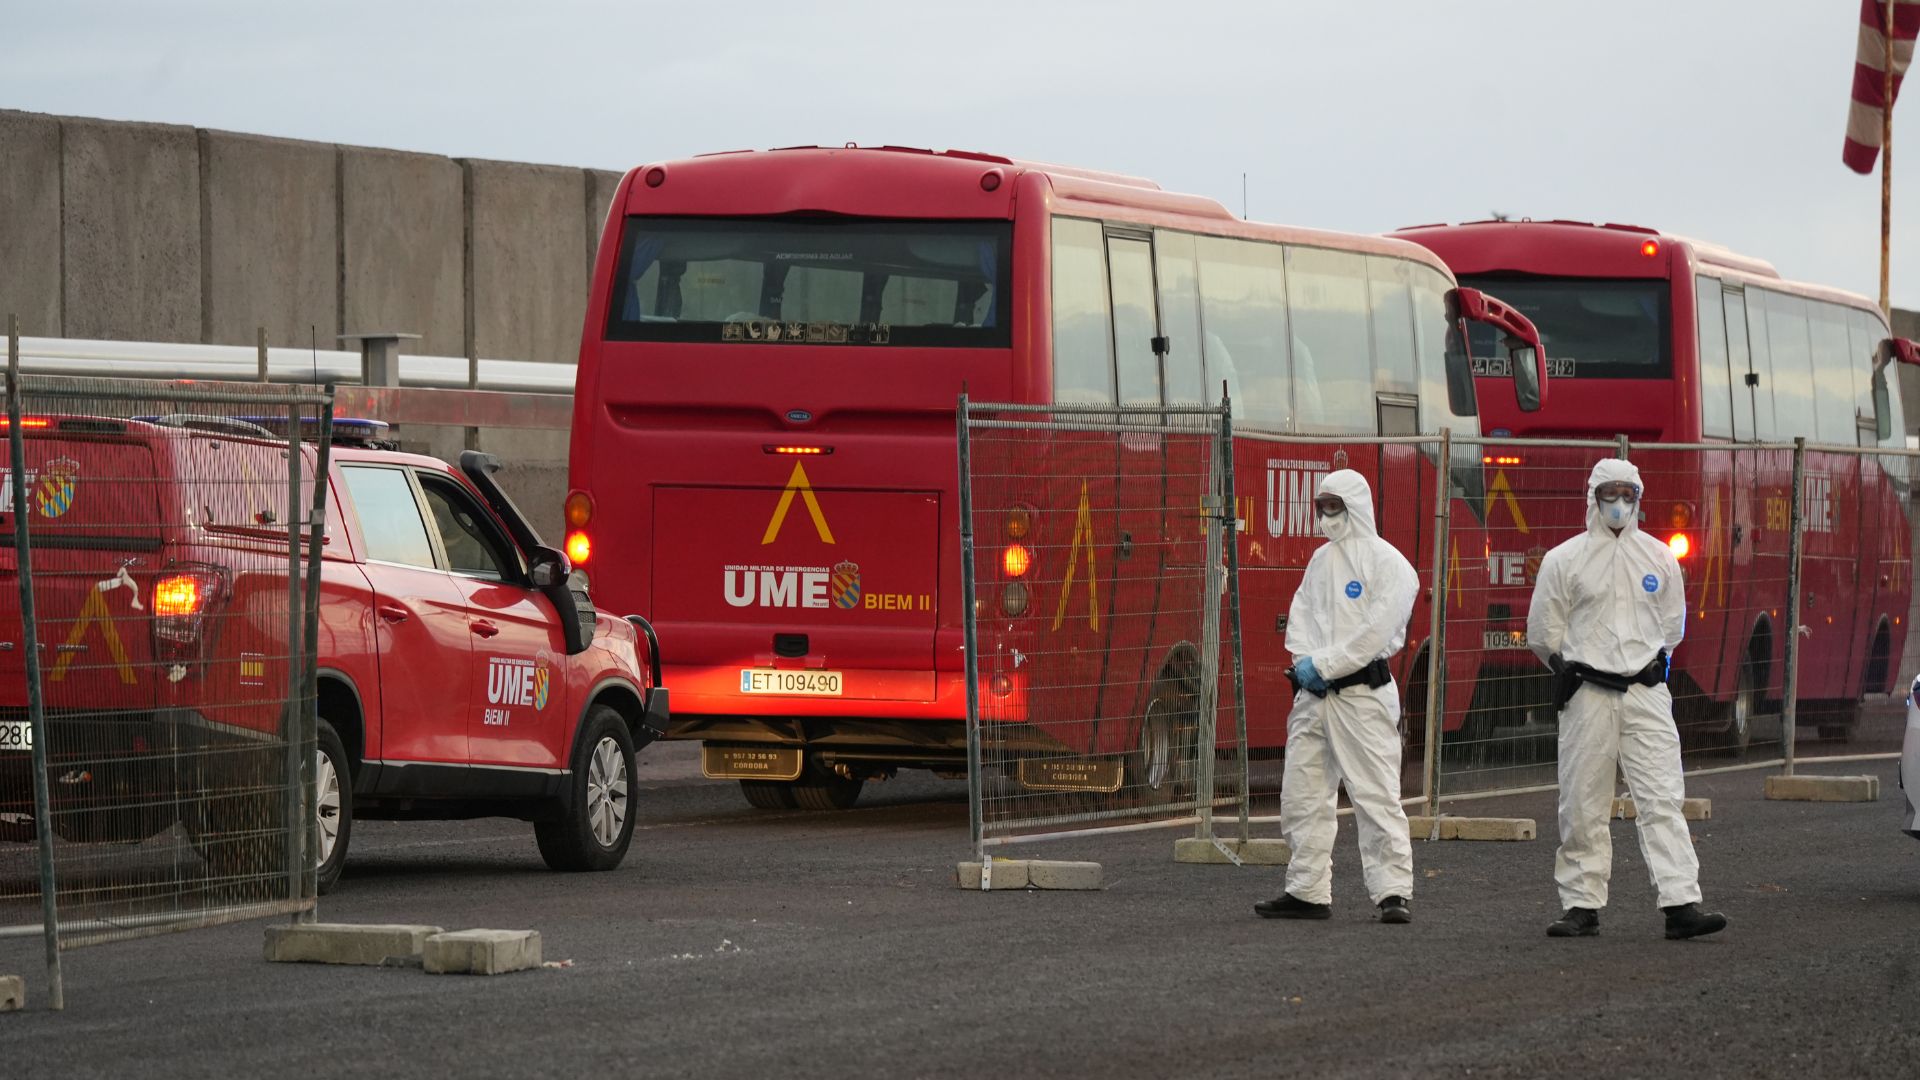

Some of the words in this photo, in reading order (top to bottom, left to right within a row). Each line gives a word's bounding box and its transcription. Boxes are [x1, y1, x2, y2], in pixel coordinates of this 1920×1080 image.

[724, 571, 830, 608] UME
[864, 593, 913, 610] BIEM
[919, 594, 930, 610] II
[1486, 632, 1527, 647] 10949
[488, 664, 535, 706] UME
[483, 708, 503, 726] BIEM
[504, 710, 510, 726] II
